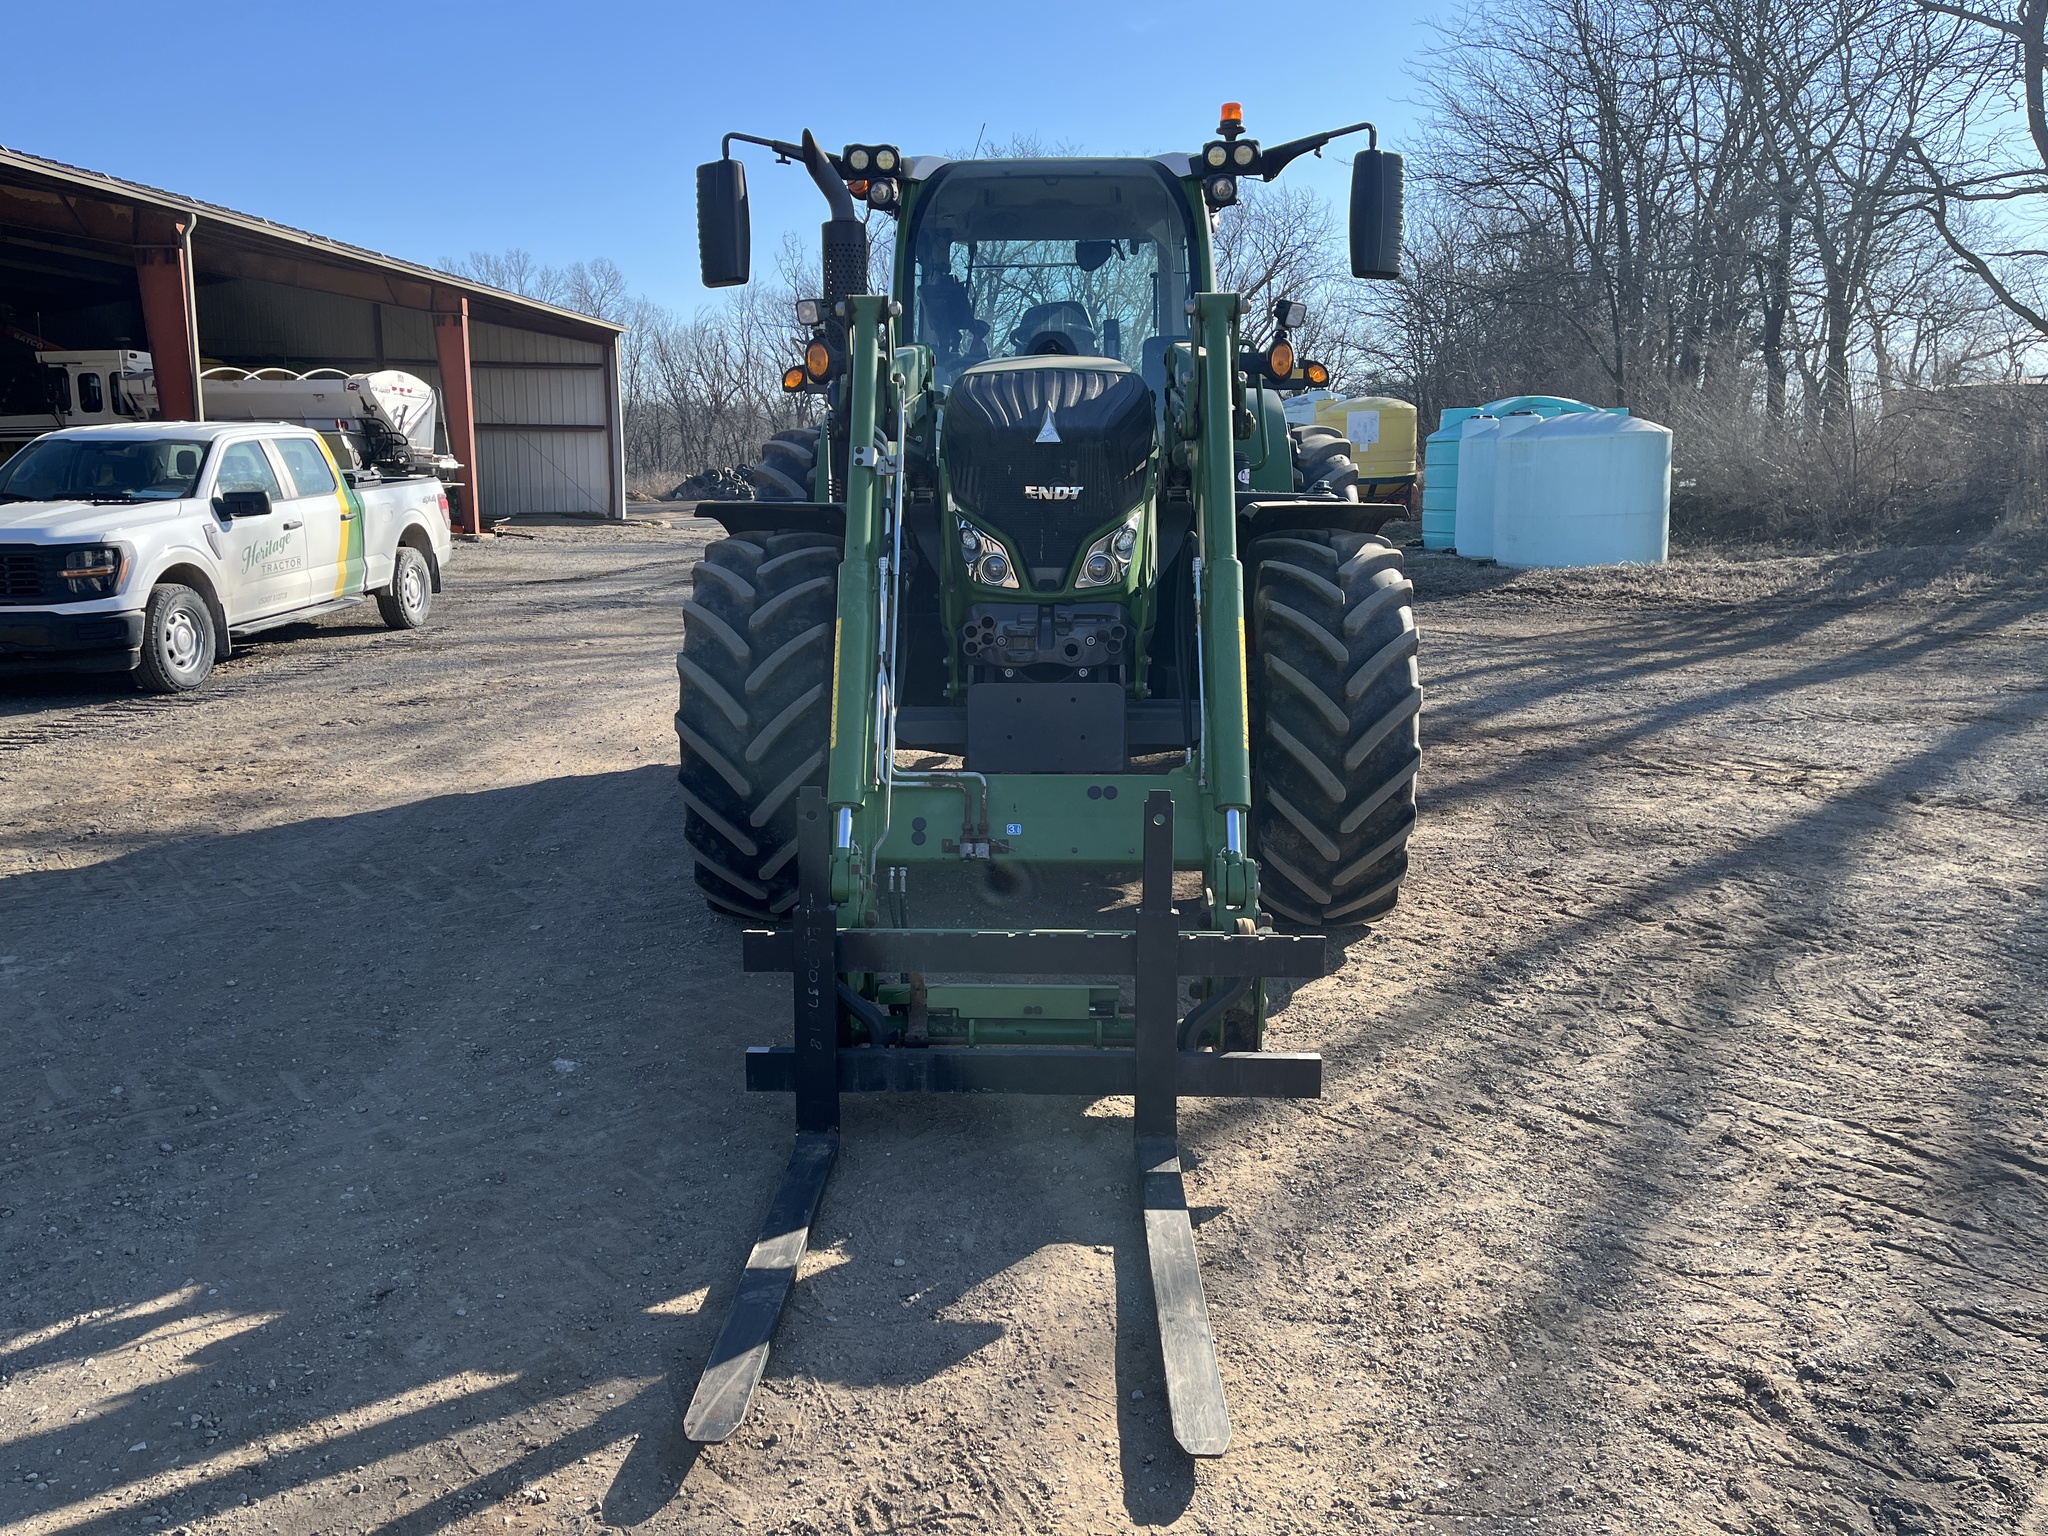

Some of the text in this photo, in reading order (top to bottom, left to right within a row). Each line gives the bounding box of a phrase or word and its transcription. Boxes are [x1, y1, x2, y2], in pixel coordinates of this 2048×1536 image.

[1025, 485, 1084, 500] ENDT
[241, 532, 291, 575] Heritage
[261, 558, 302, 573] TRACTOR
